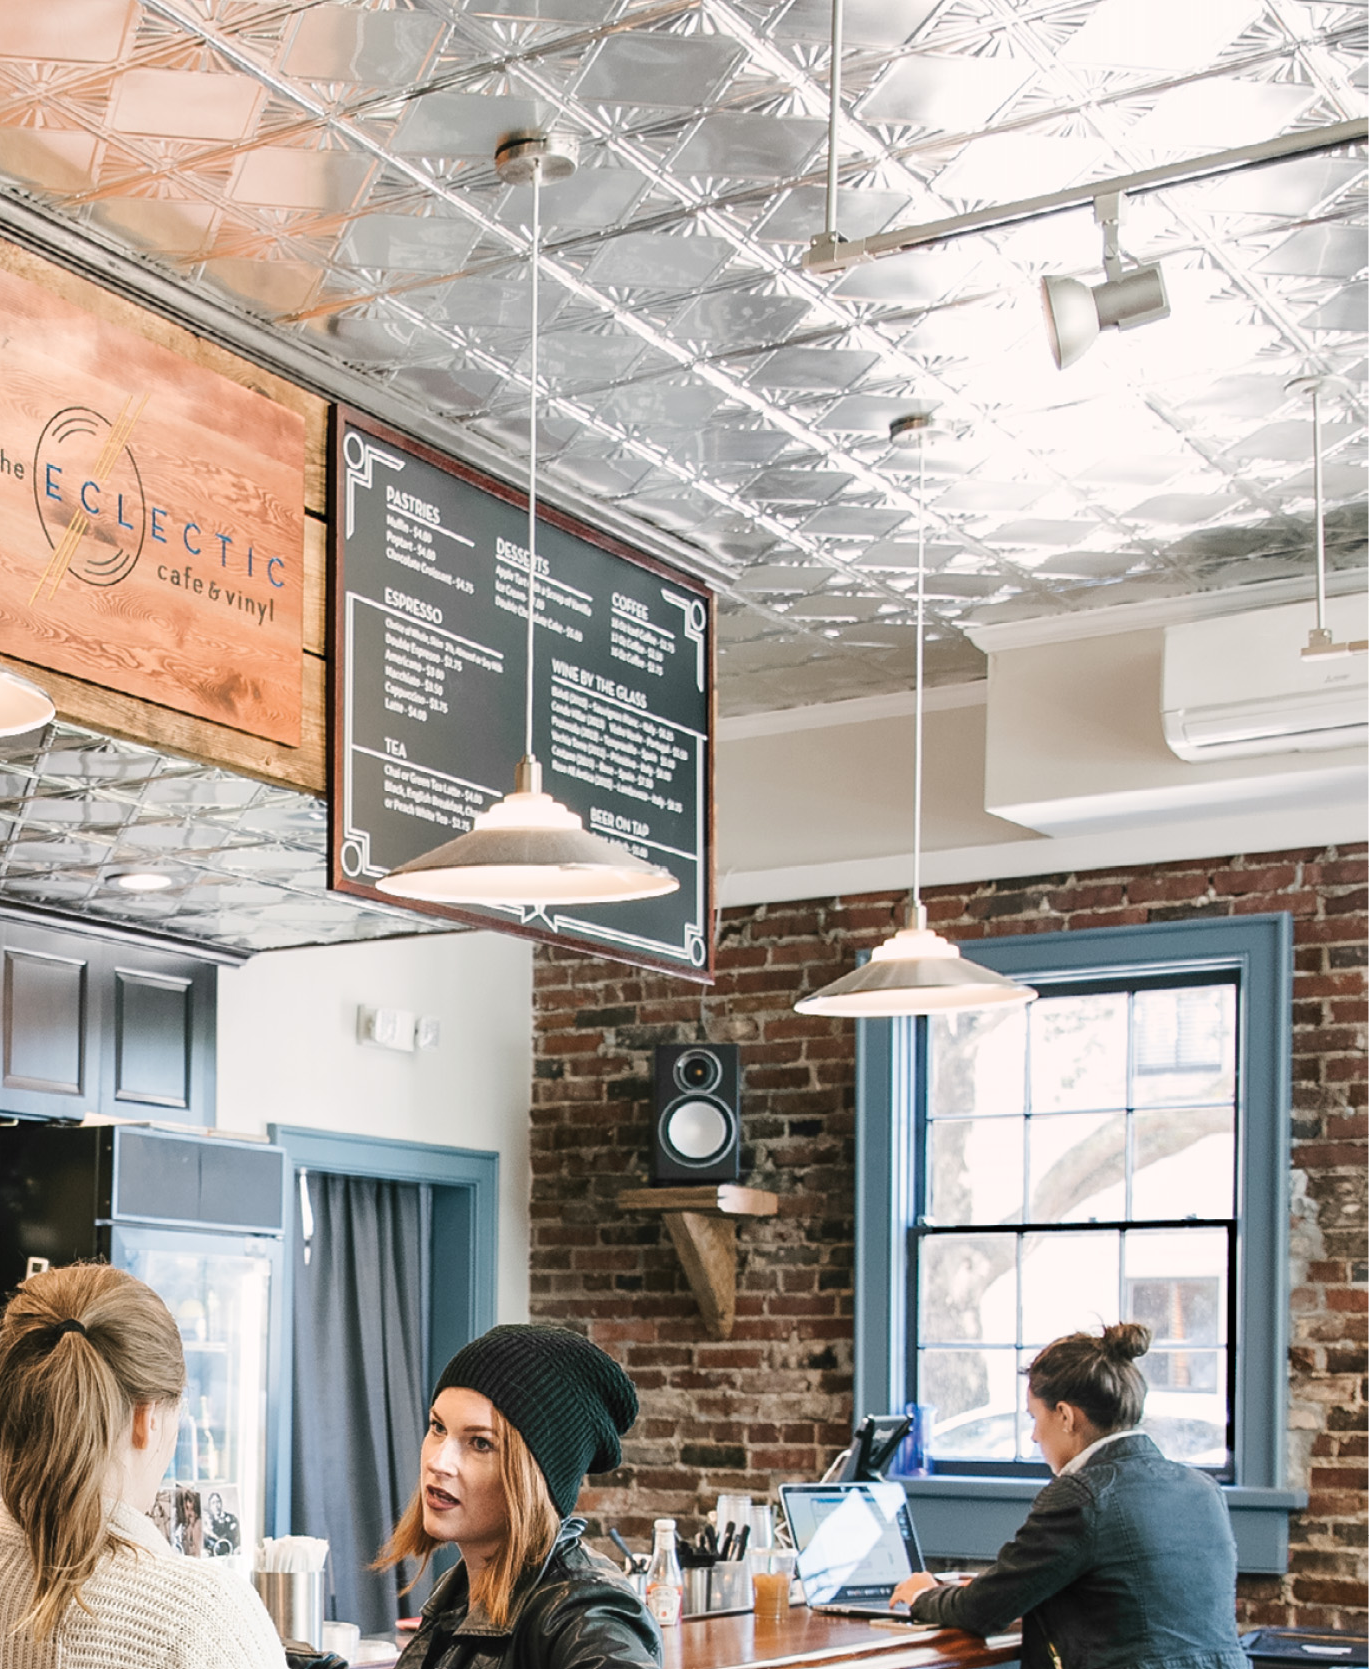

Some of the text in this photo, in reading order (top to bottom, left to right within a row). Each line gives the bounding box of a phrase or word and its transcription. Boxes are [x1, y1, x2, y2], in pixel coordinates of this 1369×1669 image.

[387, 485, 440, 524] PASTRIES
[45, 462, 285, 587] ECLECTIC
[385, 587, 442, 624] ESPRESSO
[612, 592, 648, 622] COFFEE
[552, 658, 647, 709] WINE BY THE GLASS
[384, 737, 407, 759] TEA
[590, 807, 649, 837] BEER ON TAP
